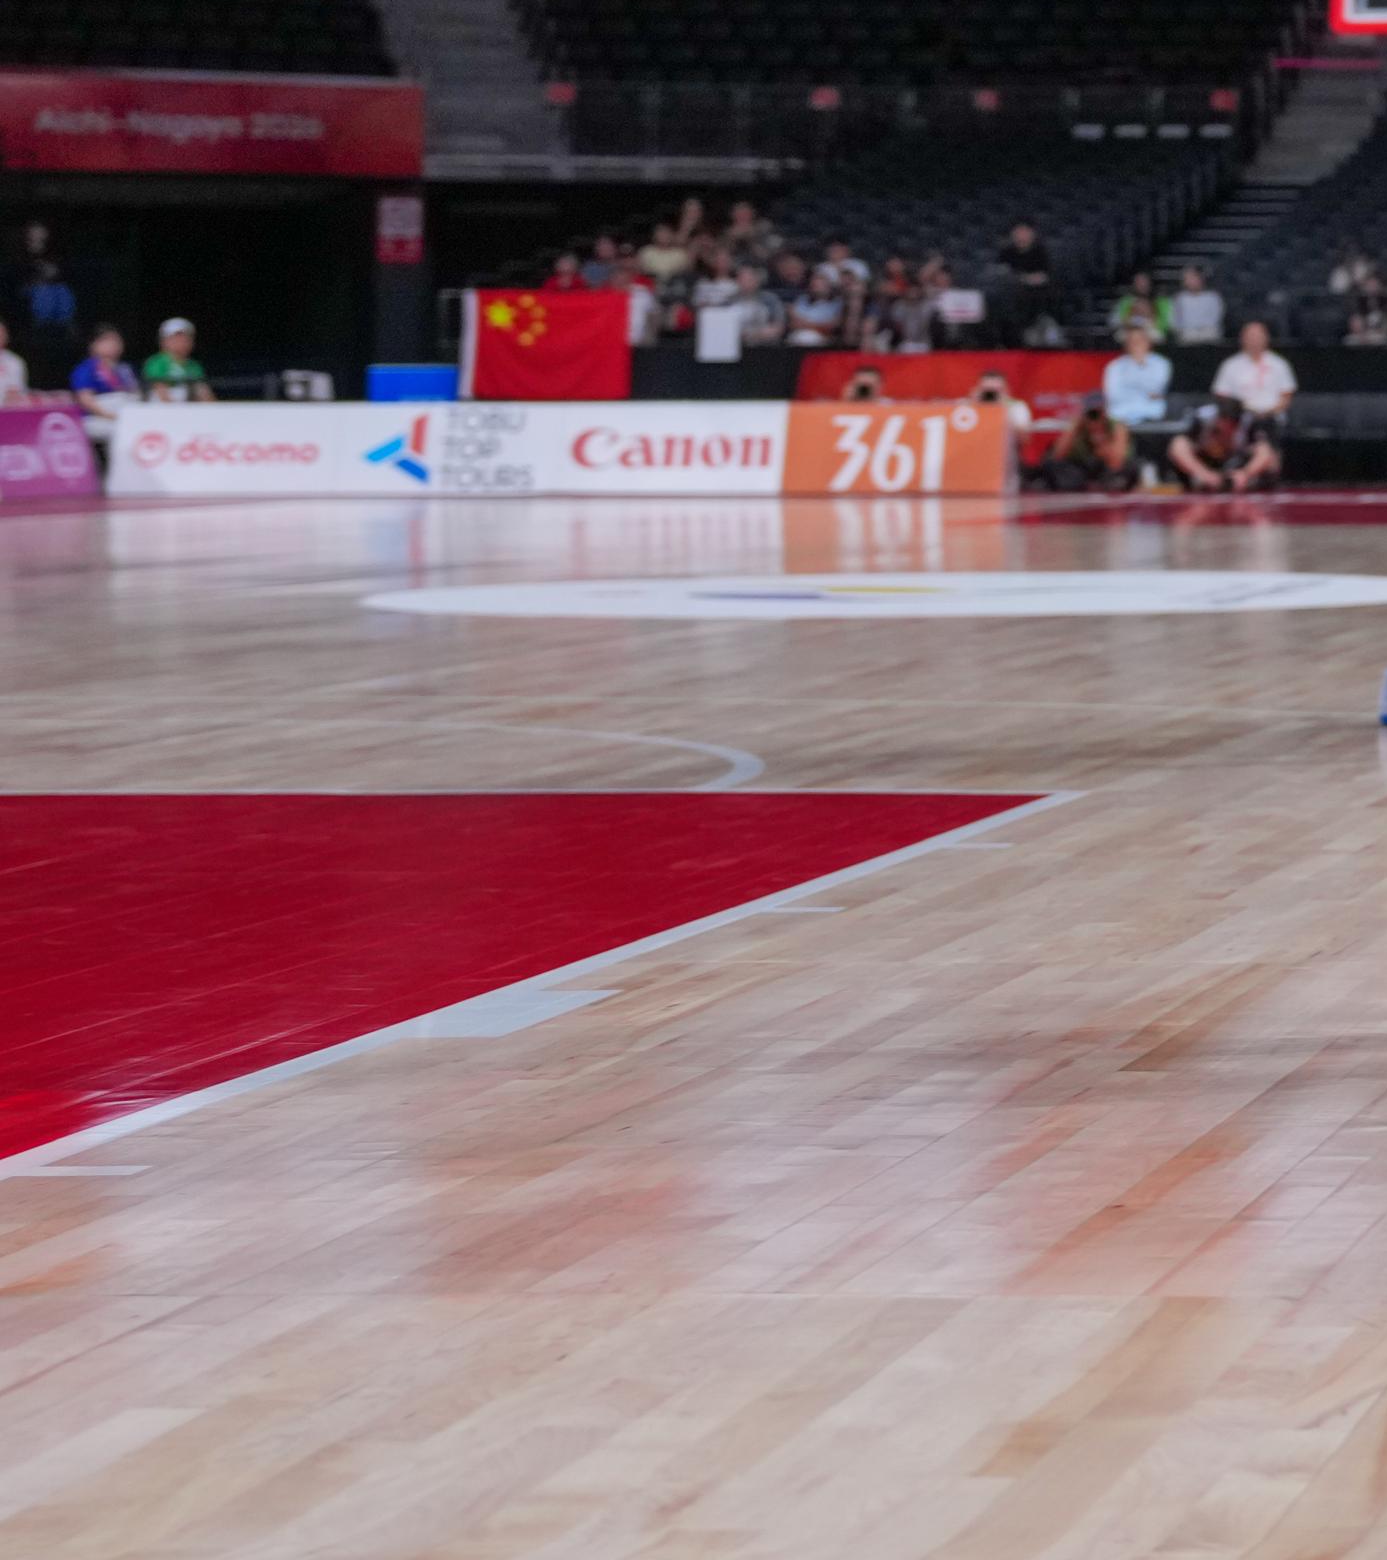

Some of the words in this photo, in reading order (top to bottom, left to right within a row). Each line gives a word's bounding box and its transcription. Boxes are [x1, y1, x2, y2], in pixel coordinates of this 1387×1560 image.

[176, 436, 319, 464] docomo
[444, 436, 502, 460] TOP
[571, 426, 771, 470] Canon
[828, 404, 979, 492] 361°
[441, 464, 534, 490] TOURS
